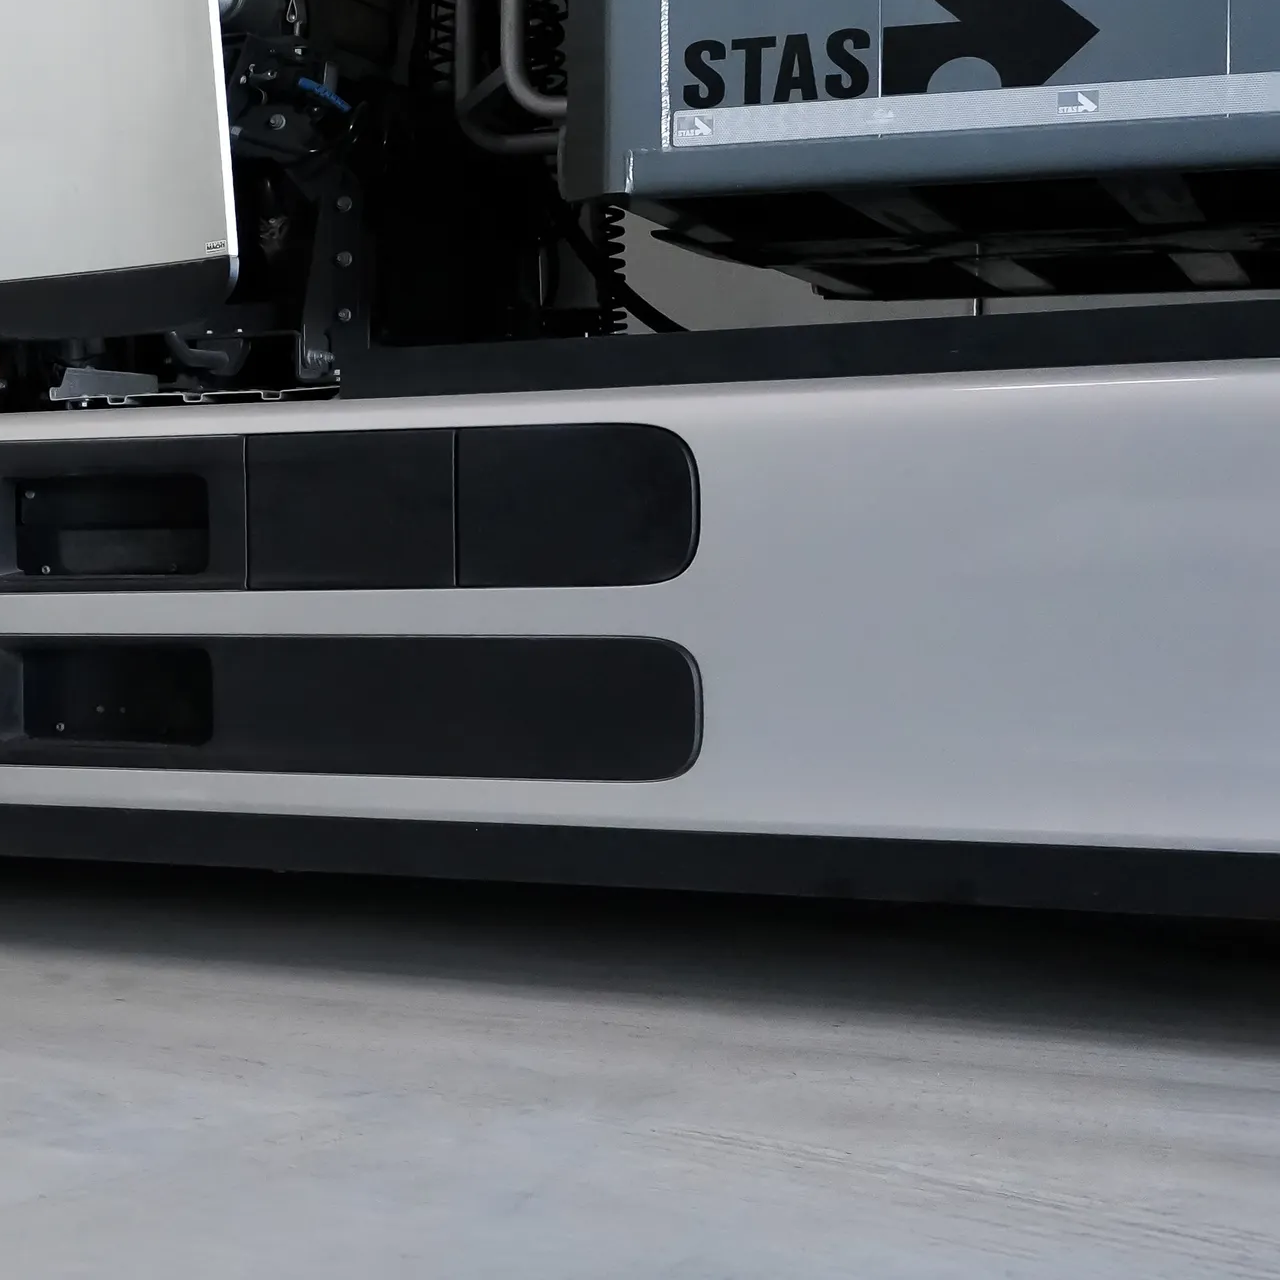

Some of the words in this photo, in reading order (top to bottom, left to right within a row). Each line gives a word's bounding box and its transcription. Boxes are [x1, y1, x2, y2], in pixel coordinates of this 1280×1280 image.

[683, 28, 871, 109] STAS
[1057, 105, 1078, 114] STAS
[677, 129, 695, 137] STAS
